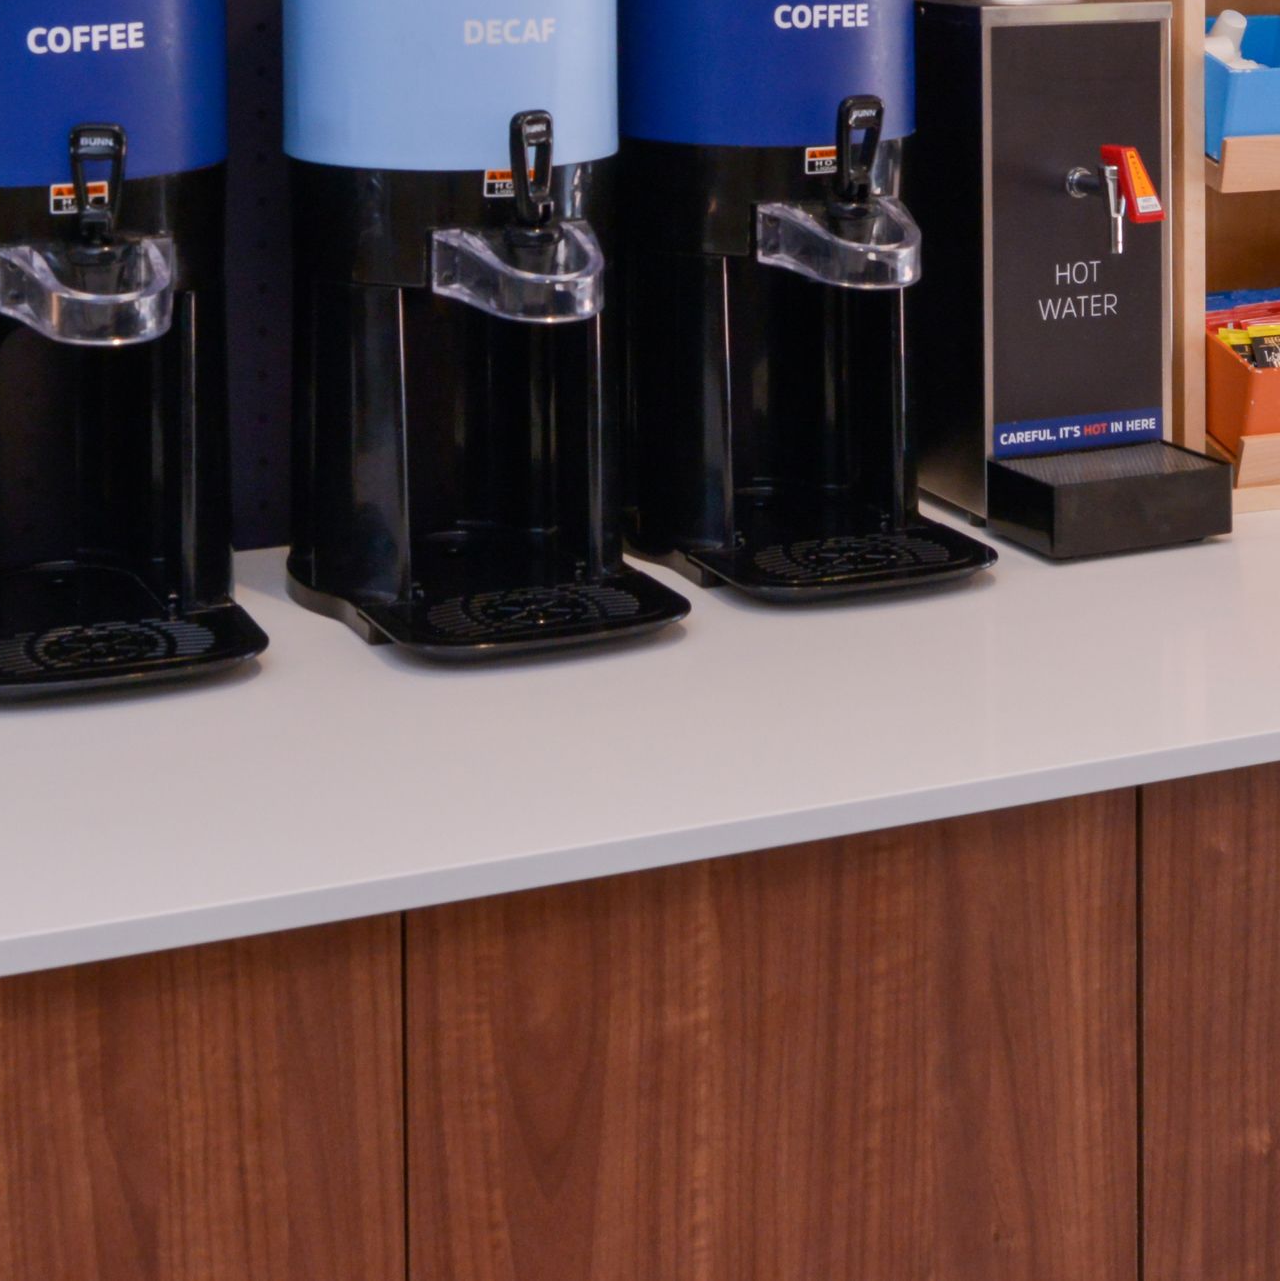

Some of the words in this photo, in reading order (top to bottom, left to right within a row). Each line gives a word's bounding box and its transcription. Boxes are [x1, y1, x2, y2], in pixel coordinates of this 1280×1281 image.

[774, 4, 869, 29] COFFEE
[26, 22, 145, 54] COFFEE
[464, 18, 557, 44] DECAF
[80, 137, 114, 147] BUNN
[1055, 260, 1102, 286] HOT
[1038, 293, 1118, 321] WATER
[999, 428, 1057, 446] CAREFUL,
[1059, 425, 1081, 439] IT'S
[1083, 422, 1108, 436] HOT
[1110, 421, 1123, 434] IN
[1126, 418, 1156, 432] HERE
